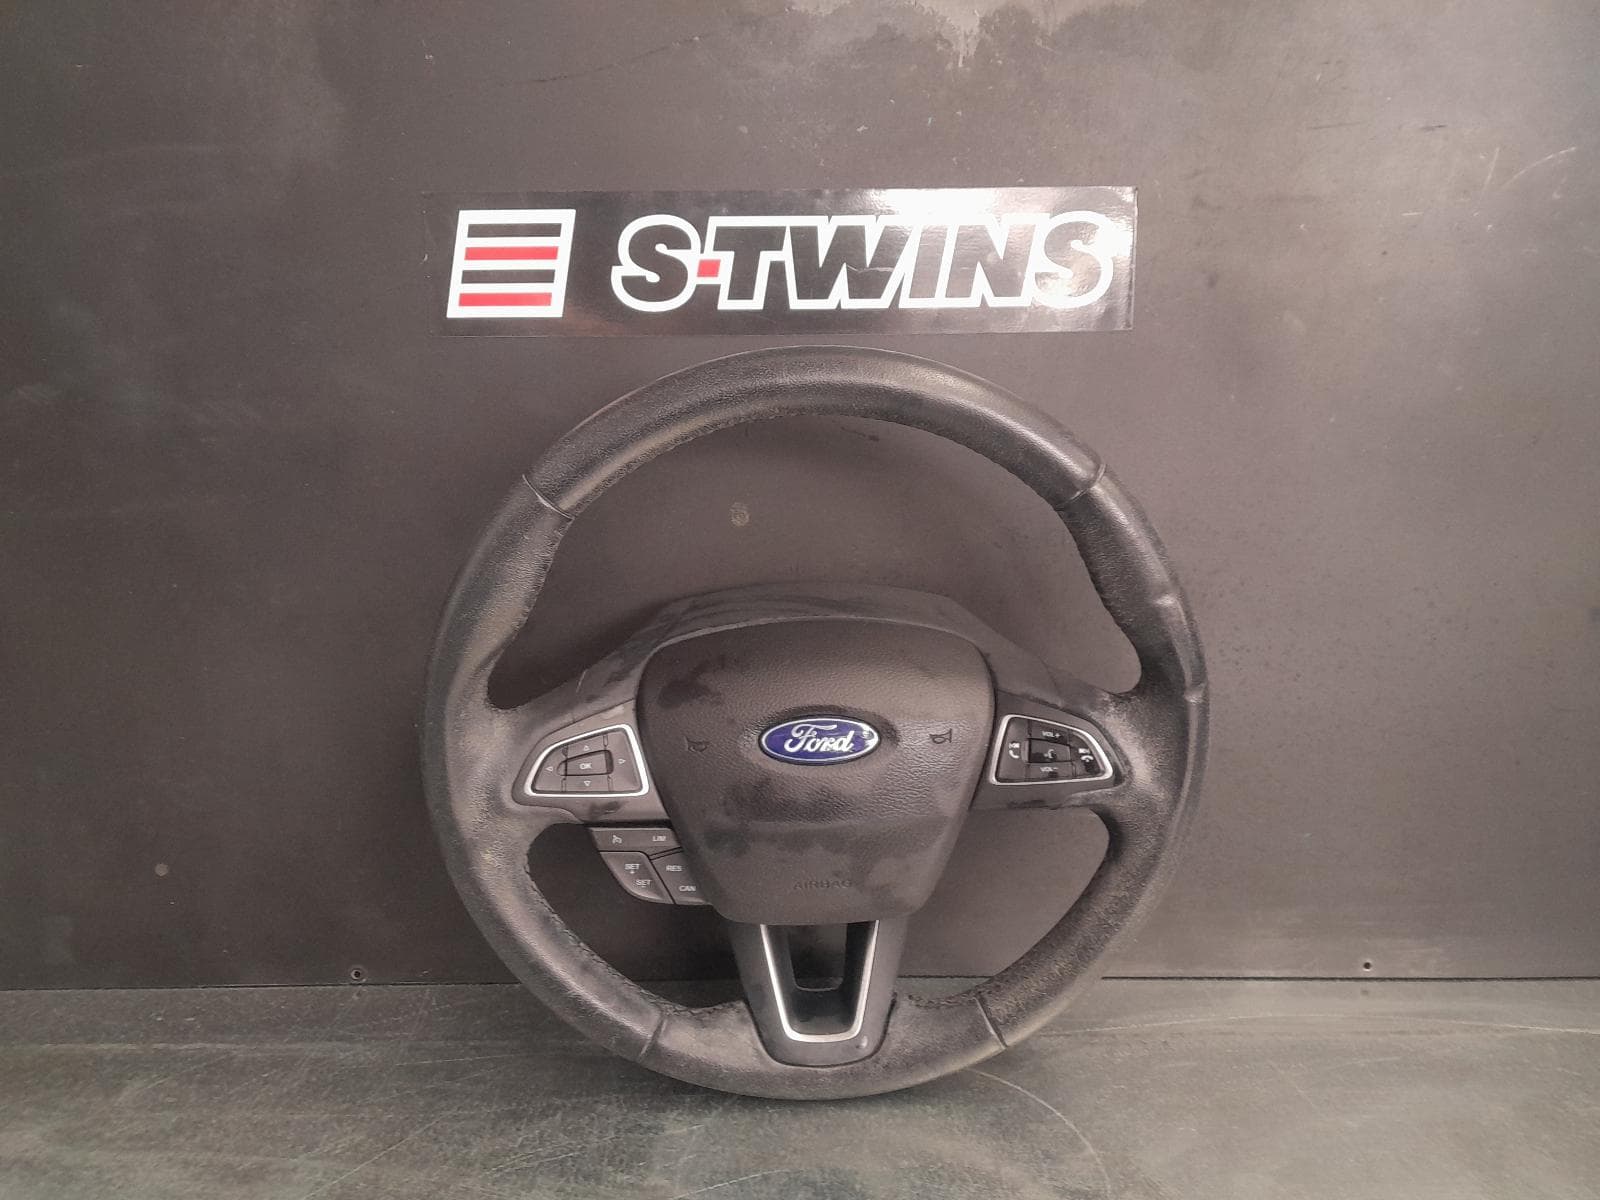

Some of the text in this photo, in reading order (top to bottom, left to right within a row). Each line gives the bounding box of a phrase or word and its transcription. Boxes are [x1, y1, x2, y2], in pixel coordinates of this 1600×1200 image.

[784, 723, 855, 752] Ford
[579, 762, 592, 770] OK
[665, 864, 683, 872] RES
[793, 880, 852, 890] AIRBAG
